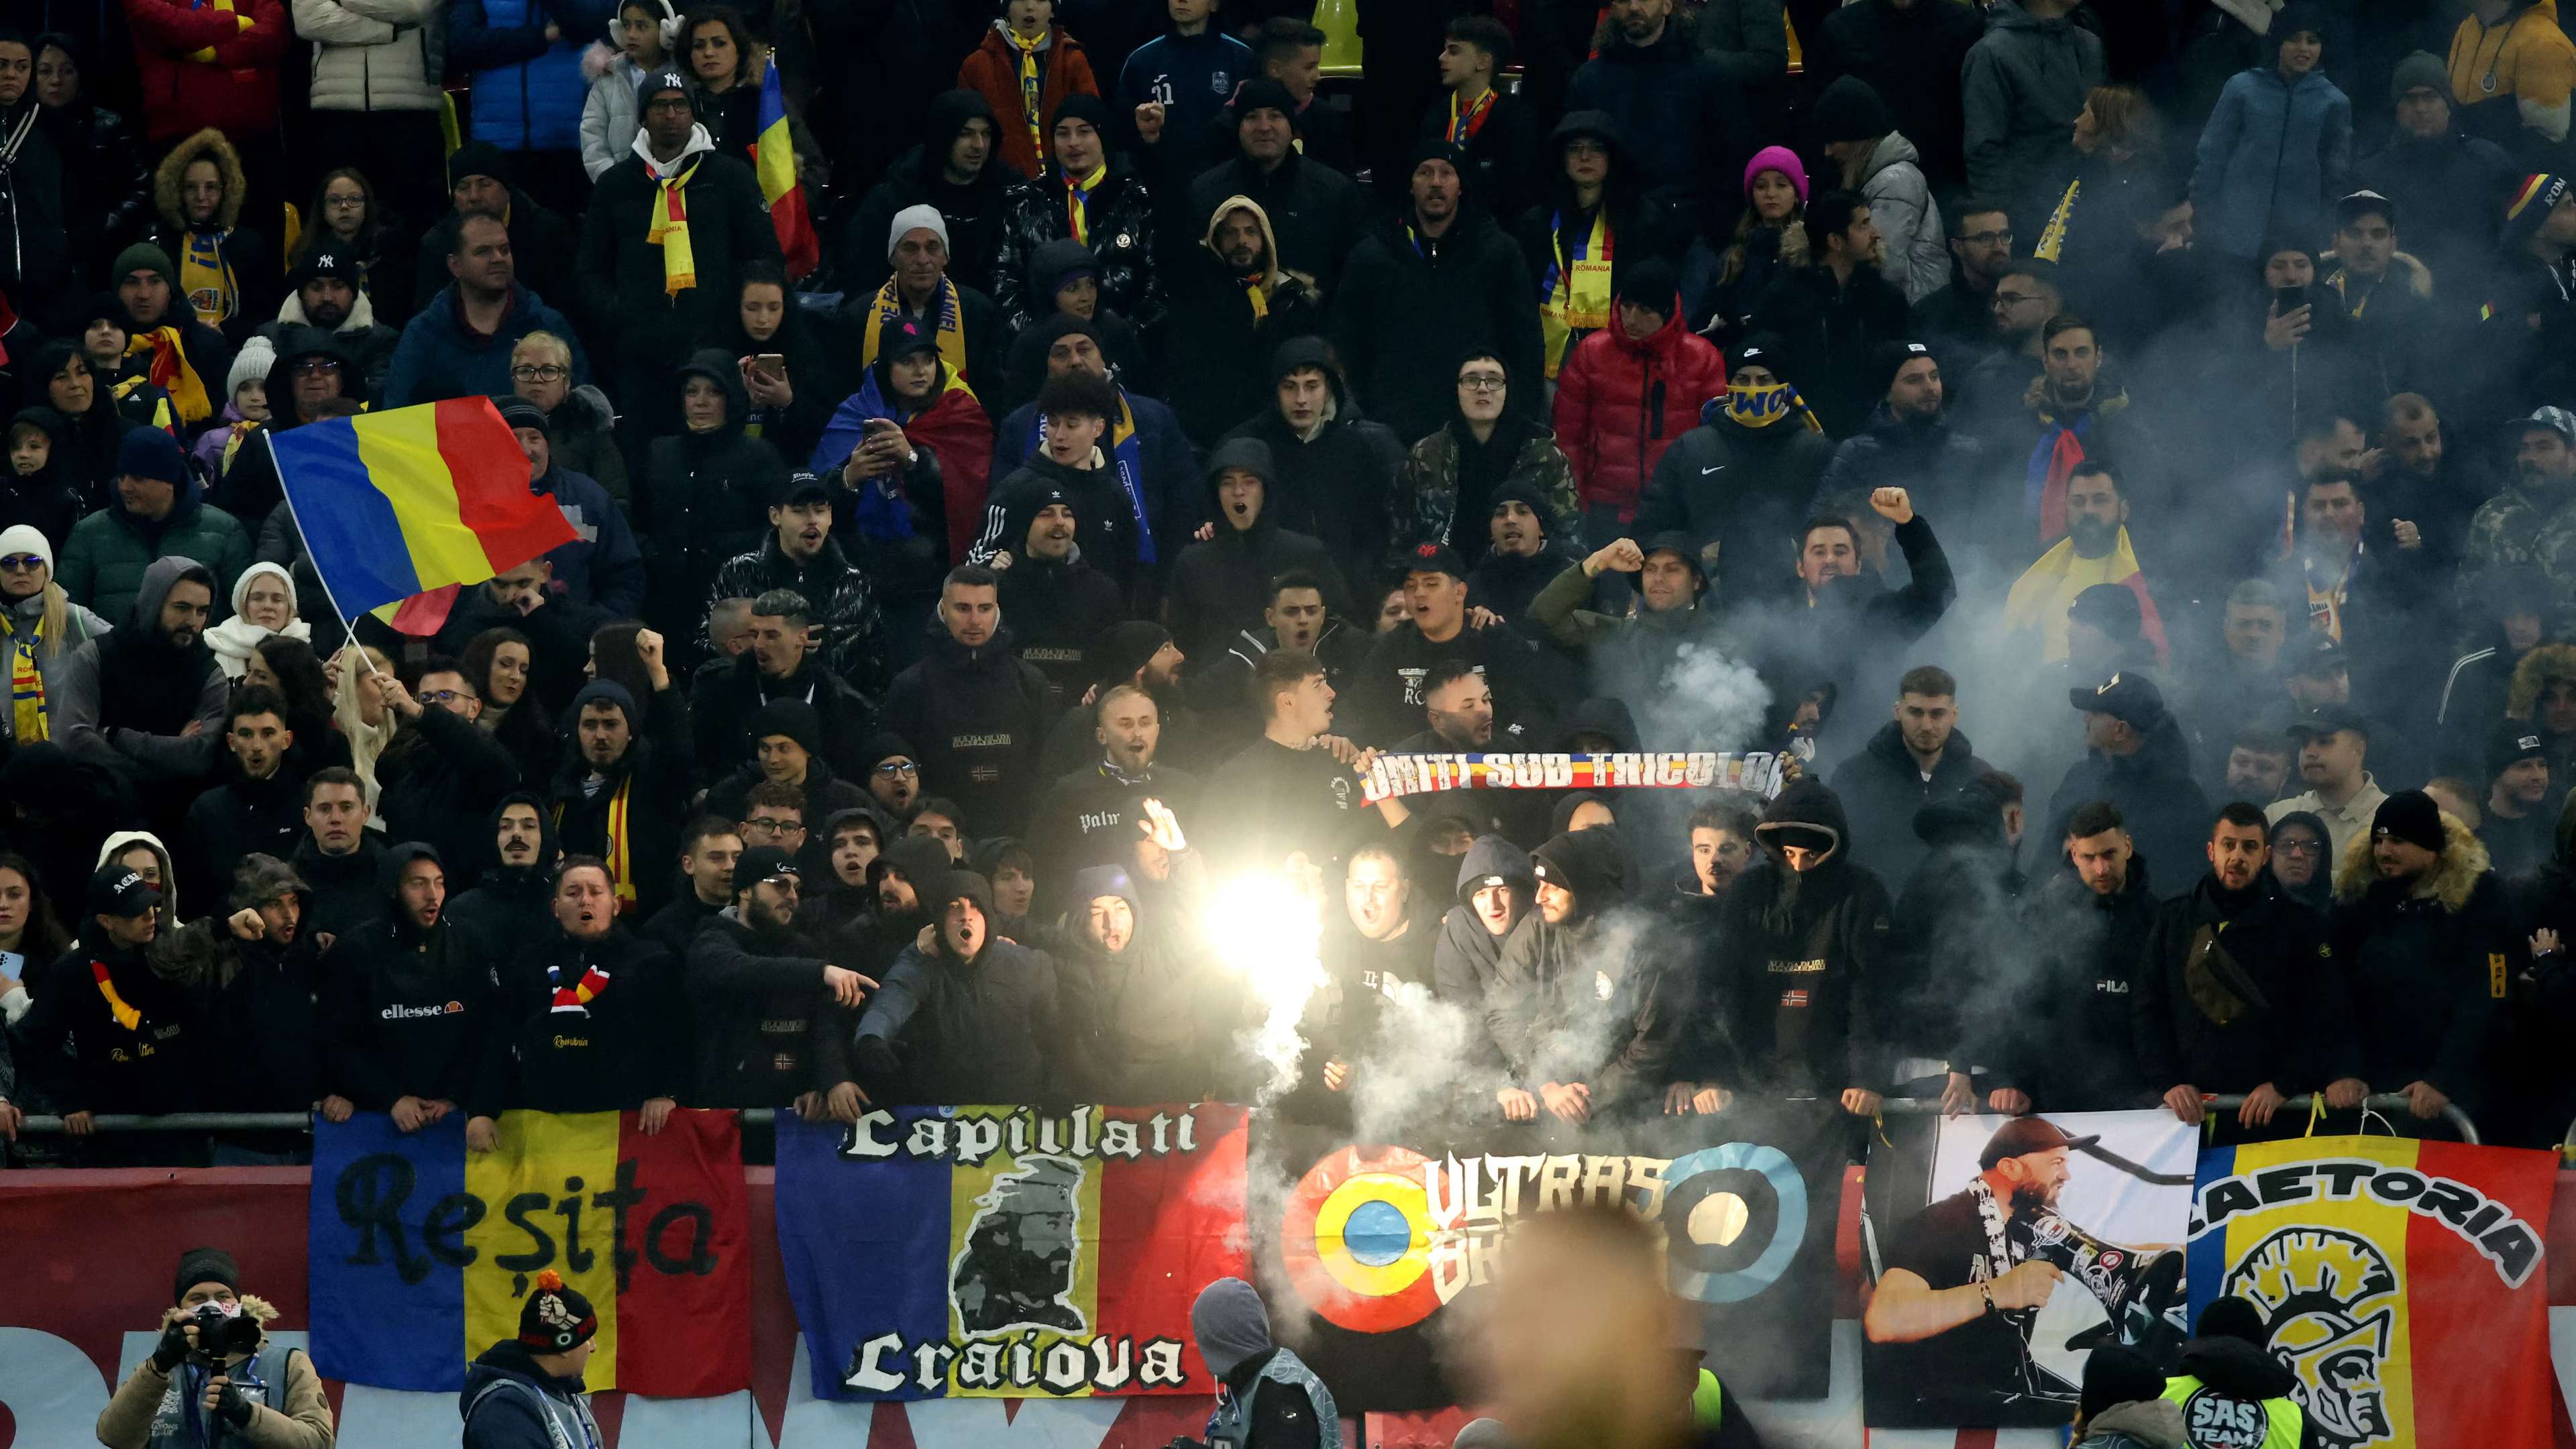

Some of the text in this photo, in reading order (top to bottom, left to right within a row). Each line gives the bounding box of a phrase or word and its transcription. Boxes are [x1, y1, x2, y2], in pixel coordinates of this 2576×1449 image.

[1575, 264, 1611, 272] ROMANIA
[1483, 751, 1574, 788] SUB
[2096, 980, 2129, 994] FILA
[382, 1004, 443, 1019] ellesse
[2187, 1163, 2545, 1283] AETORIA
[845, 1331, 1185, 1393] Craiova
[2192, 1396, 2257, 1434] SAS
[2191, 1426, 2254, 1447] TEAM
